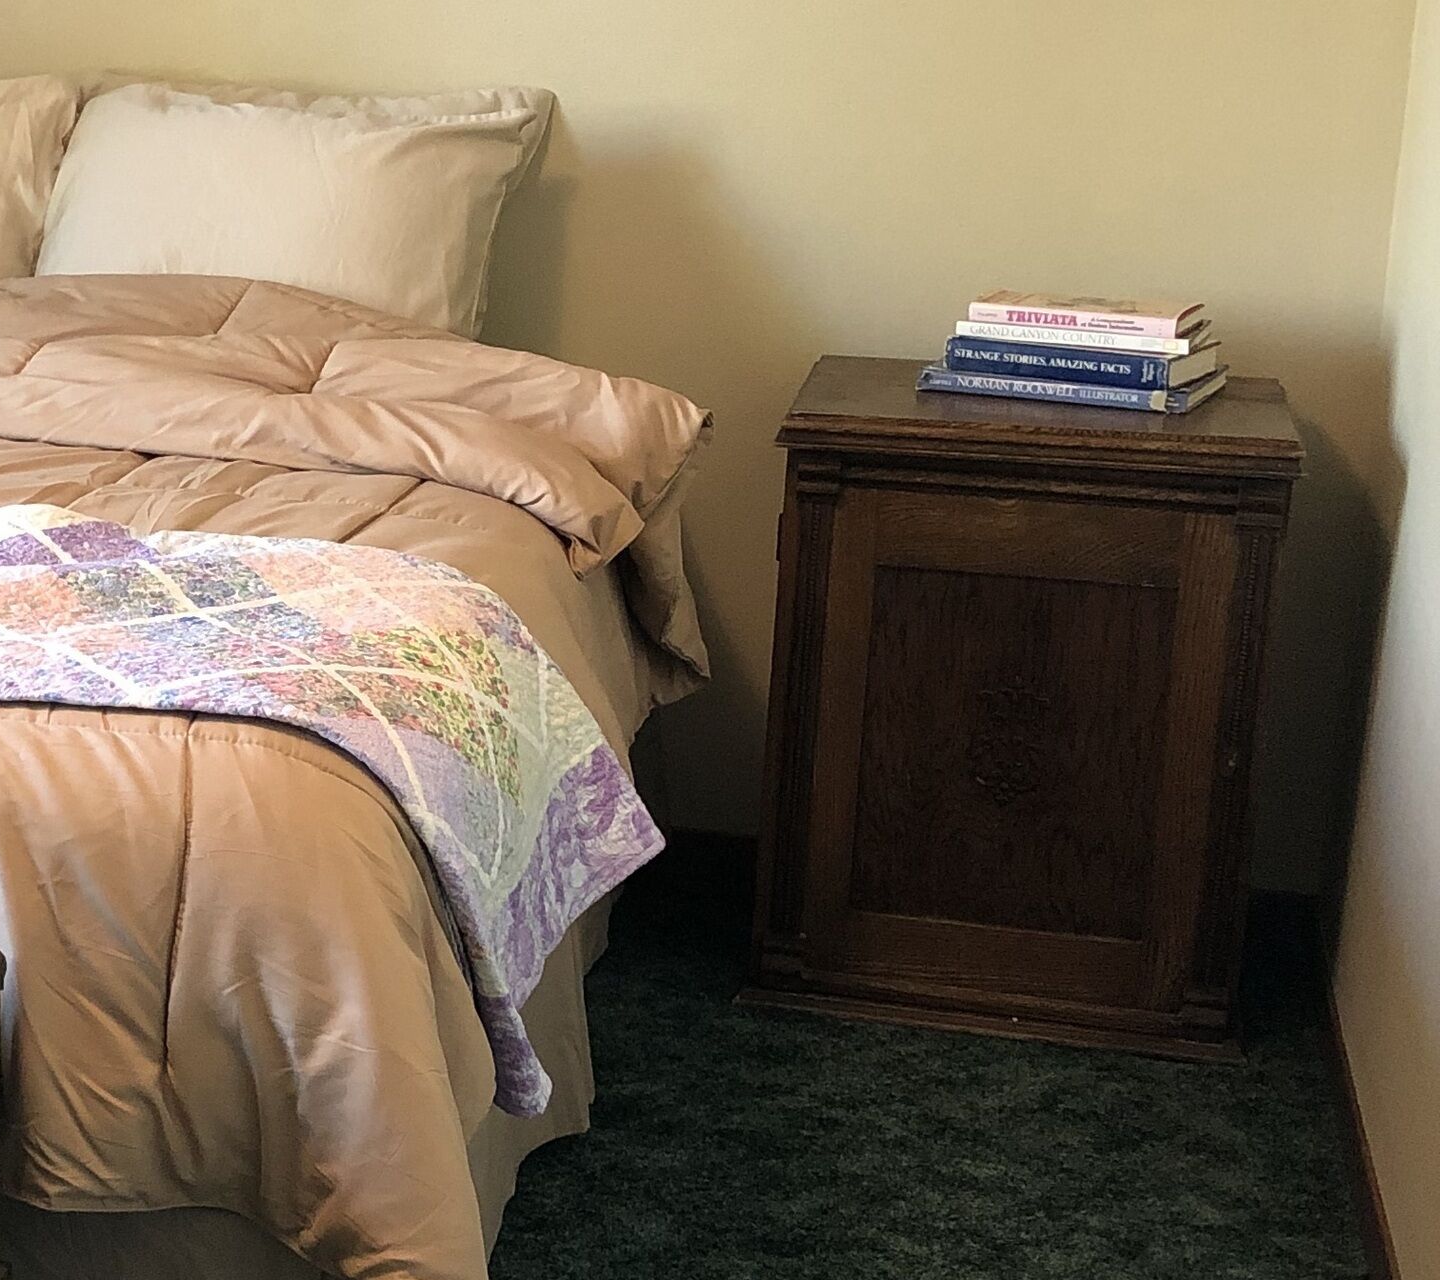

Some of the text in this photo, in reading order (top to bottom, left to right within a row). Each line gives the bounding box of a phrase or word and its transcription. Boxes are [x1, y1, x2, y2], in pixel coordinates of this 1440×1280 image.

[1006, 310, 1079, 327] TRIVIATA
[970, 326, 1118, 346] GRAND CANYON COUNTRY
[954, 348, 1001, 361] STRANGE
[1048, 357, 1098, 371] AMAZING
[1100, 363, 1132, 375] FACTS
[956, 376, 1010, 391] NORMAN
[1012, 382, 1076, 397] ROCKWELL
[1078, 389, 1139, 403] ILLUSTRATOR
